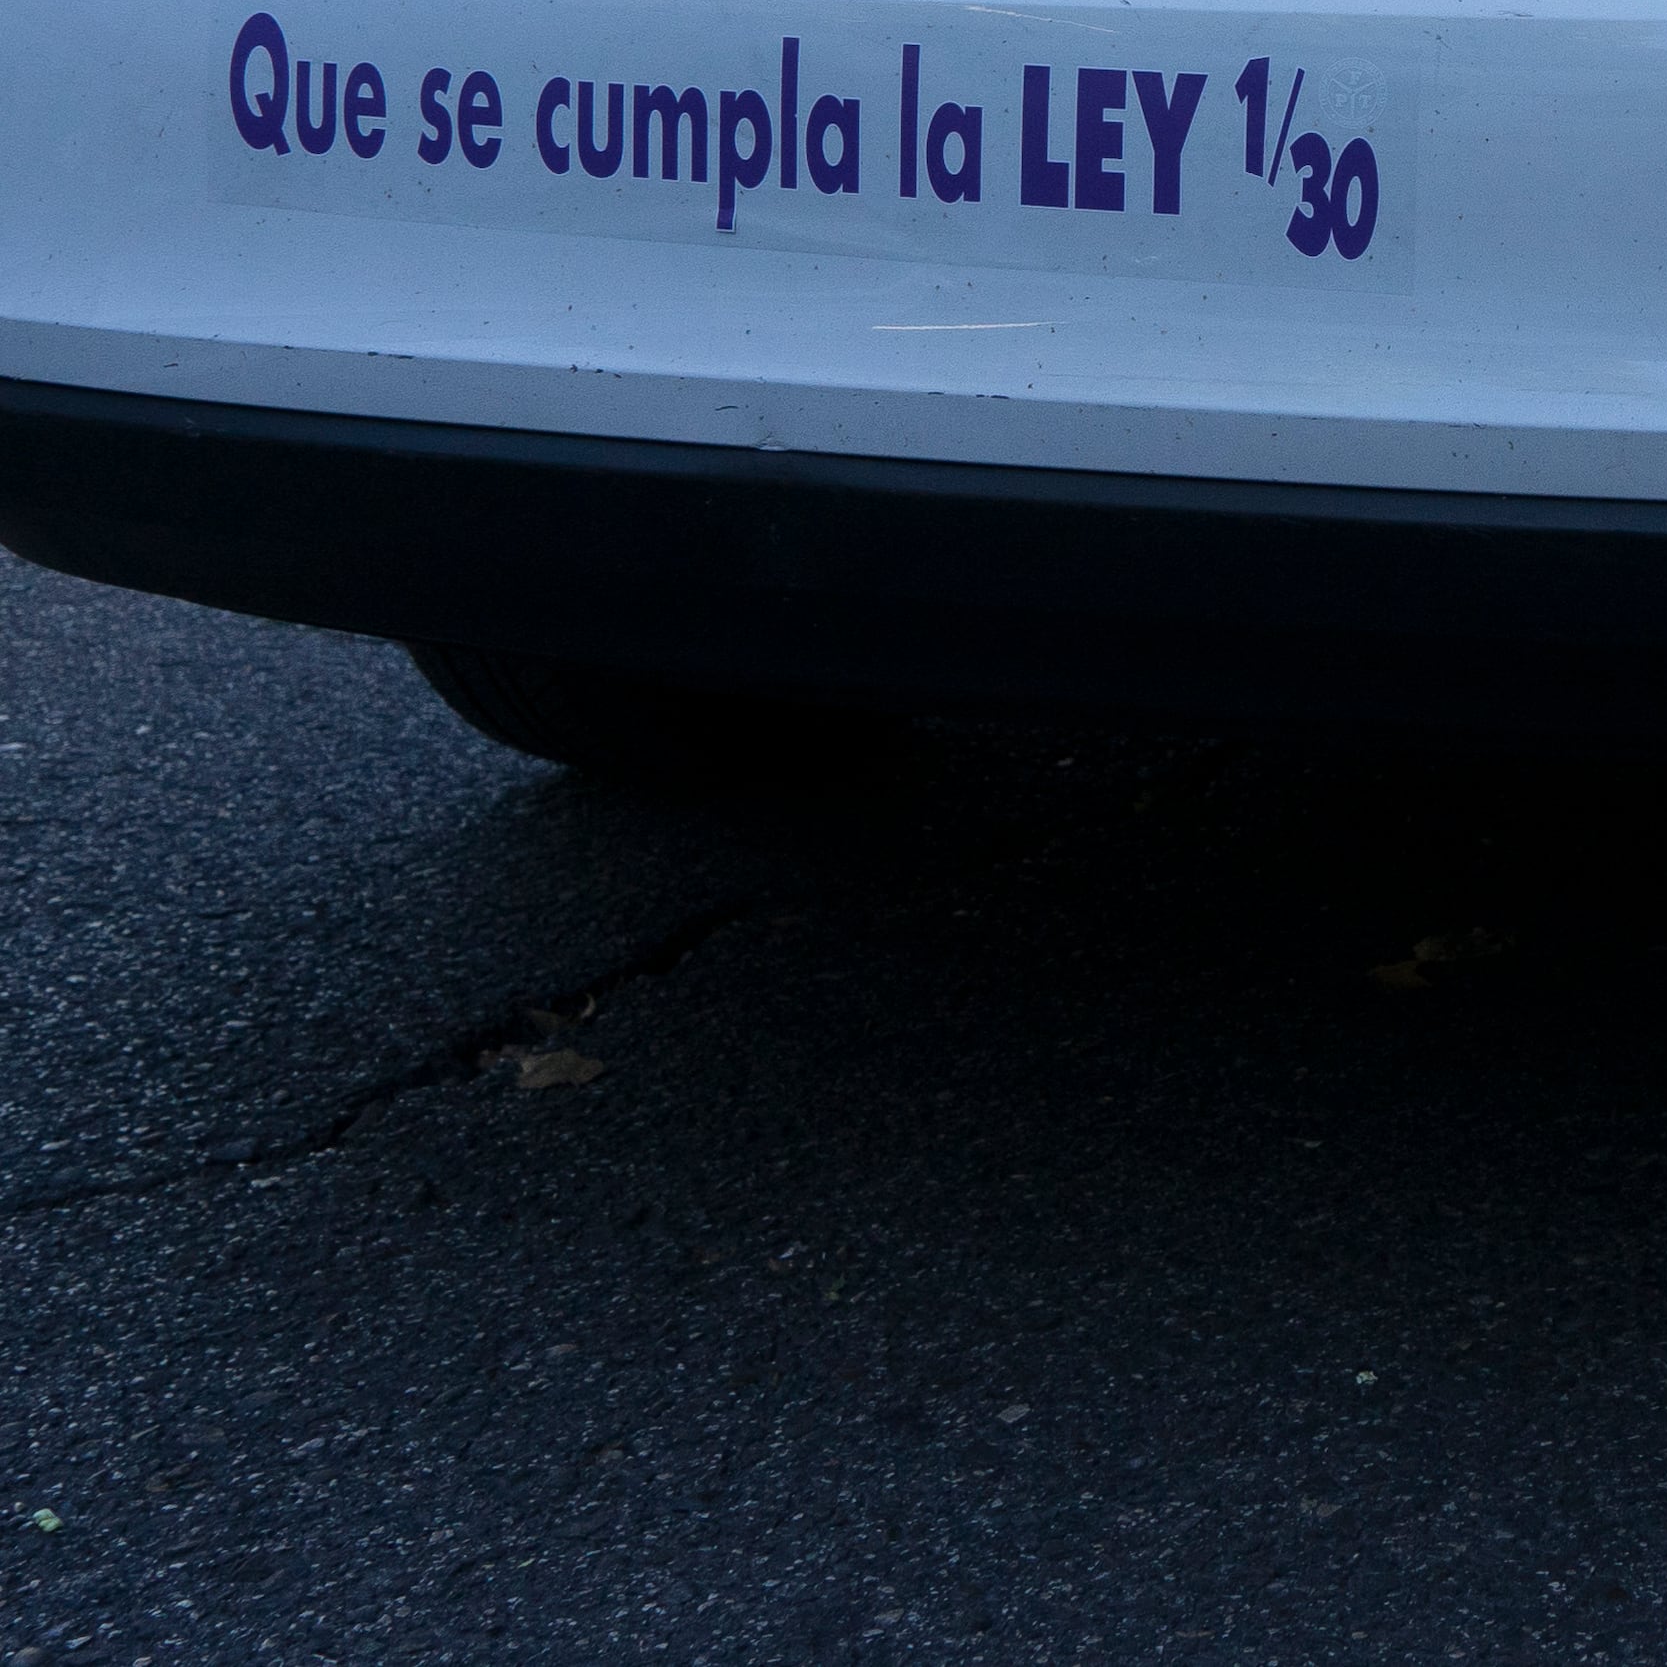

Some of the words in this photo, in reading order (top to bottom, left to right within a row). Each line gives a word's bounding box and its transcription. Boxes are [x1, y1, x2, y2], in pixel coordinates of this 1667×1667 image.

[230, 12, 387, 159] Que
[418, 67, 503, 169] se
[536, 36, 861, 231] cumpla
[899, 43, 983, 204] la
[1020, 64, 1208, 215] LEY
[1234, 56, 1379, 261] 1/30
